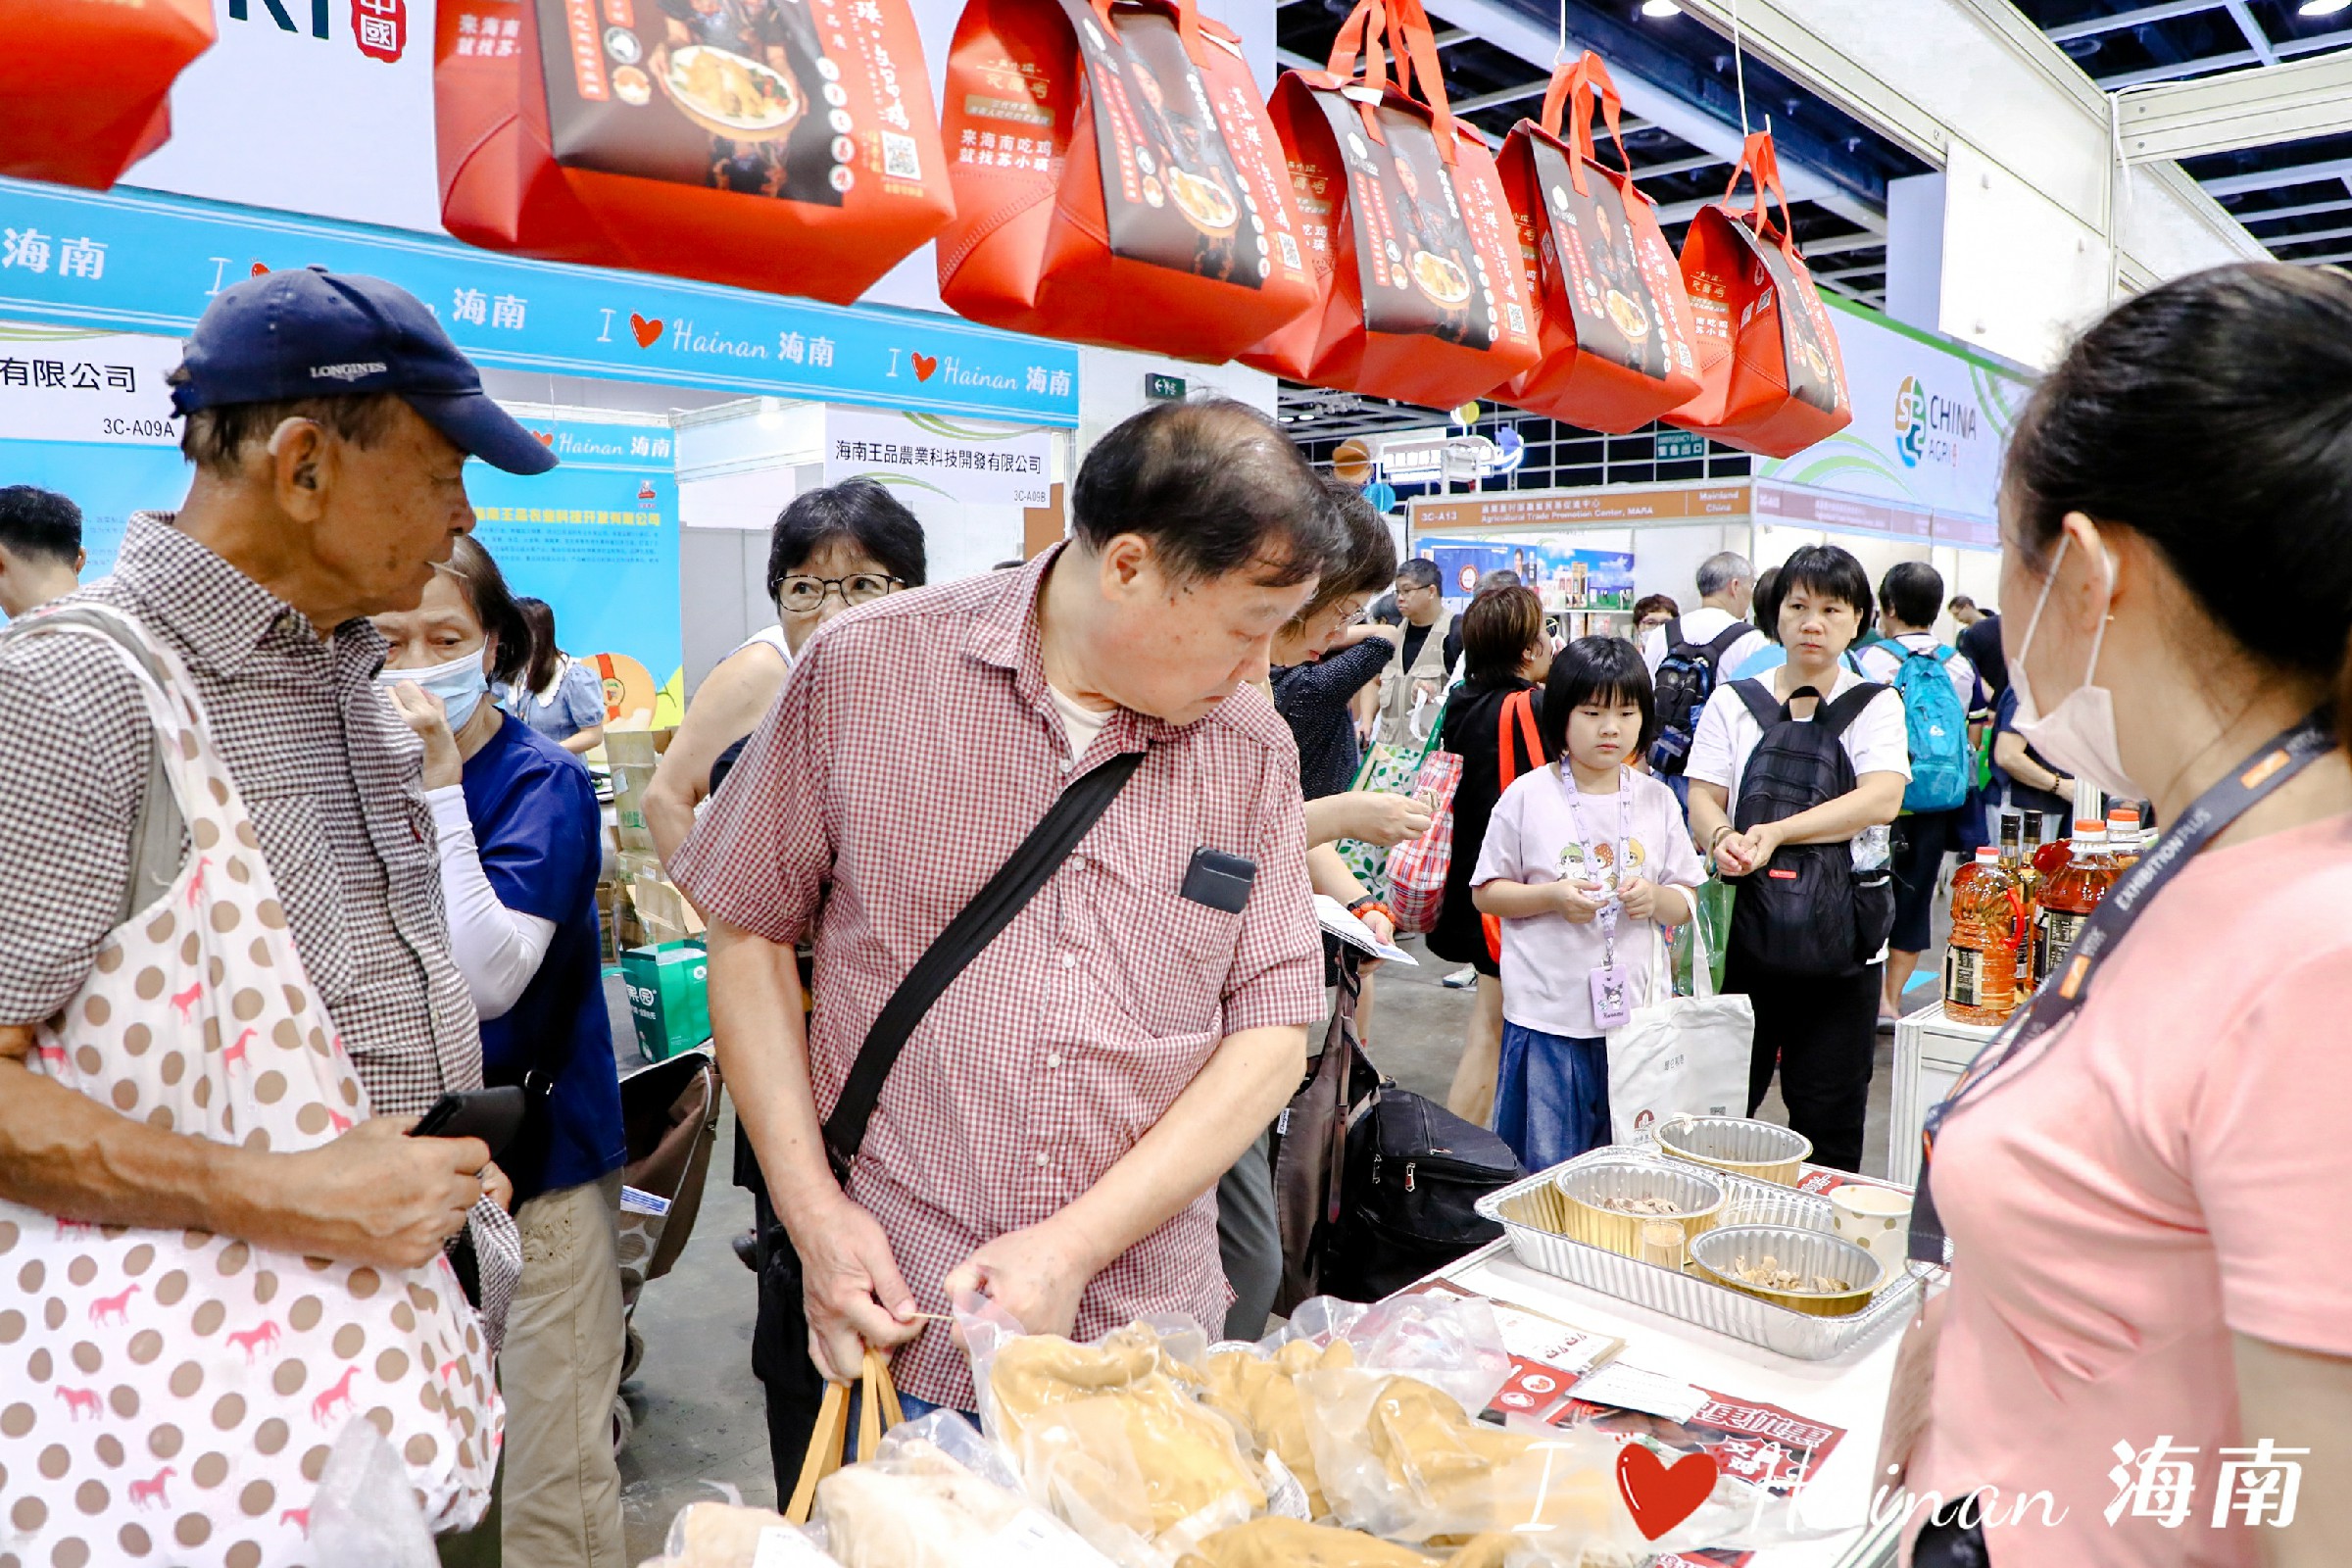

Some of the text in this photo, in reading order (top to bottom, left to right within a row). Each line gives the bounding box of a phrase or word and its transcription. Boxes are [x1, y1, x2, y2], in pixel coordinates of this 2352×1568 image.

[2, 227, 109, 280] 海南
[204, 257, 233, 296] I
[452, 286, 529, 330] 海南
[596, 308, 836, 368] I Hainan 海南
[0, 356, 137, 394] 有限公司
[310, 361, 388, 378] LONGINES
[886, 348, 1073, 398] I Hainan 海南
[103, 416, 176, 438] 3C-A09A
[1930, 394, 1977, 441] CHINA
[559, 431, 671, 459] Hainan 海南
[835, 439, 1042, 474] 海南王品農業科技開發有限公司
[1013, 489, 1047, 504] 3C-A09B
[1699, 490, 1740, 501] Mainland
[1705, 503, 1732, 513] China
[1420, 511, 1457, 521] 3C-A13
[1481, 513, 1525, 524] Agricultural
[1527, 513, 1550, 521] Trade
[1551, 510, 1592, 520] Promotion
